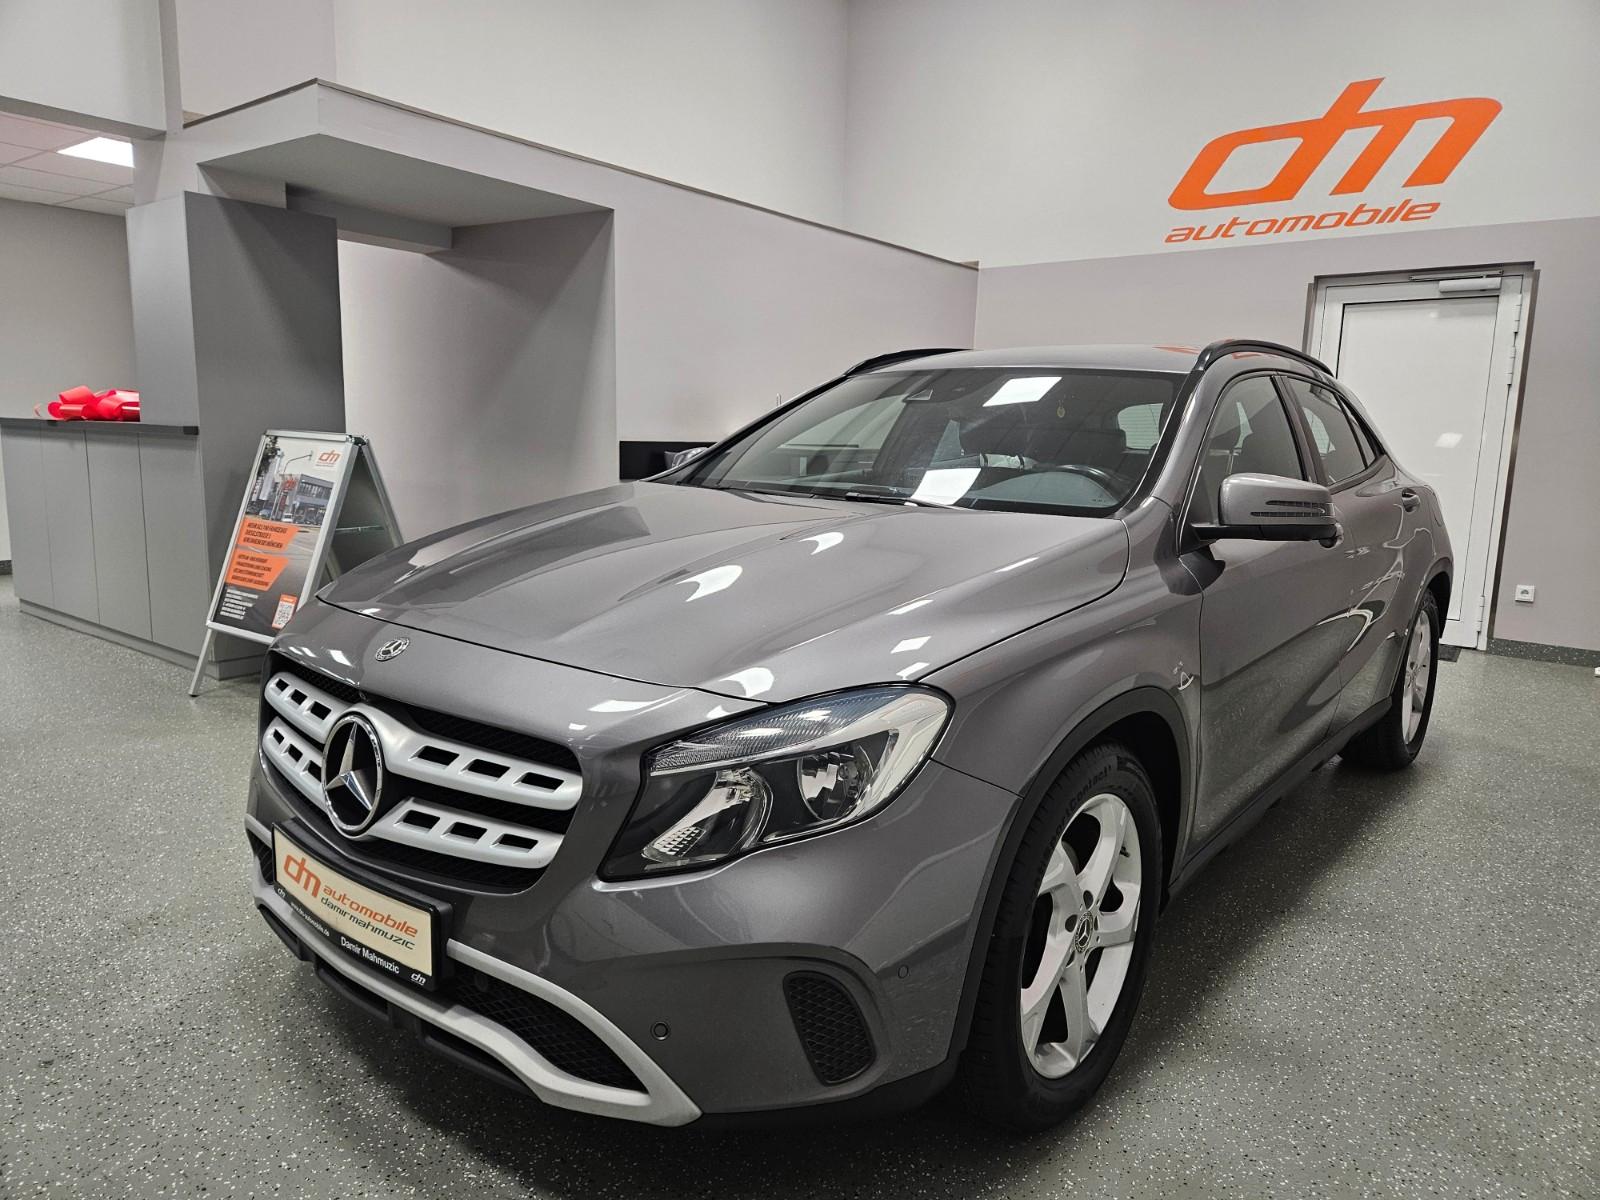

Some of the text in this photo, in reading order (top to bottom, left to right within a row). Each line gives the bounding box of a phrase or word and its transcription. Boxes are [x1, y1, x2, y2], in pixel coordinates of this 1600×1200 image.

[1168, 77, 1502, 210] dm
[1163, 198, 1441, 243] automobile
[283, 854, 321, 898] dm
[323, 884, 418, 938] automobile
[340, 936, 361, 954] Damir
[362, 947, 400, 974] Mahmuzic
